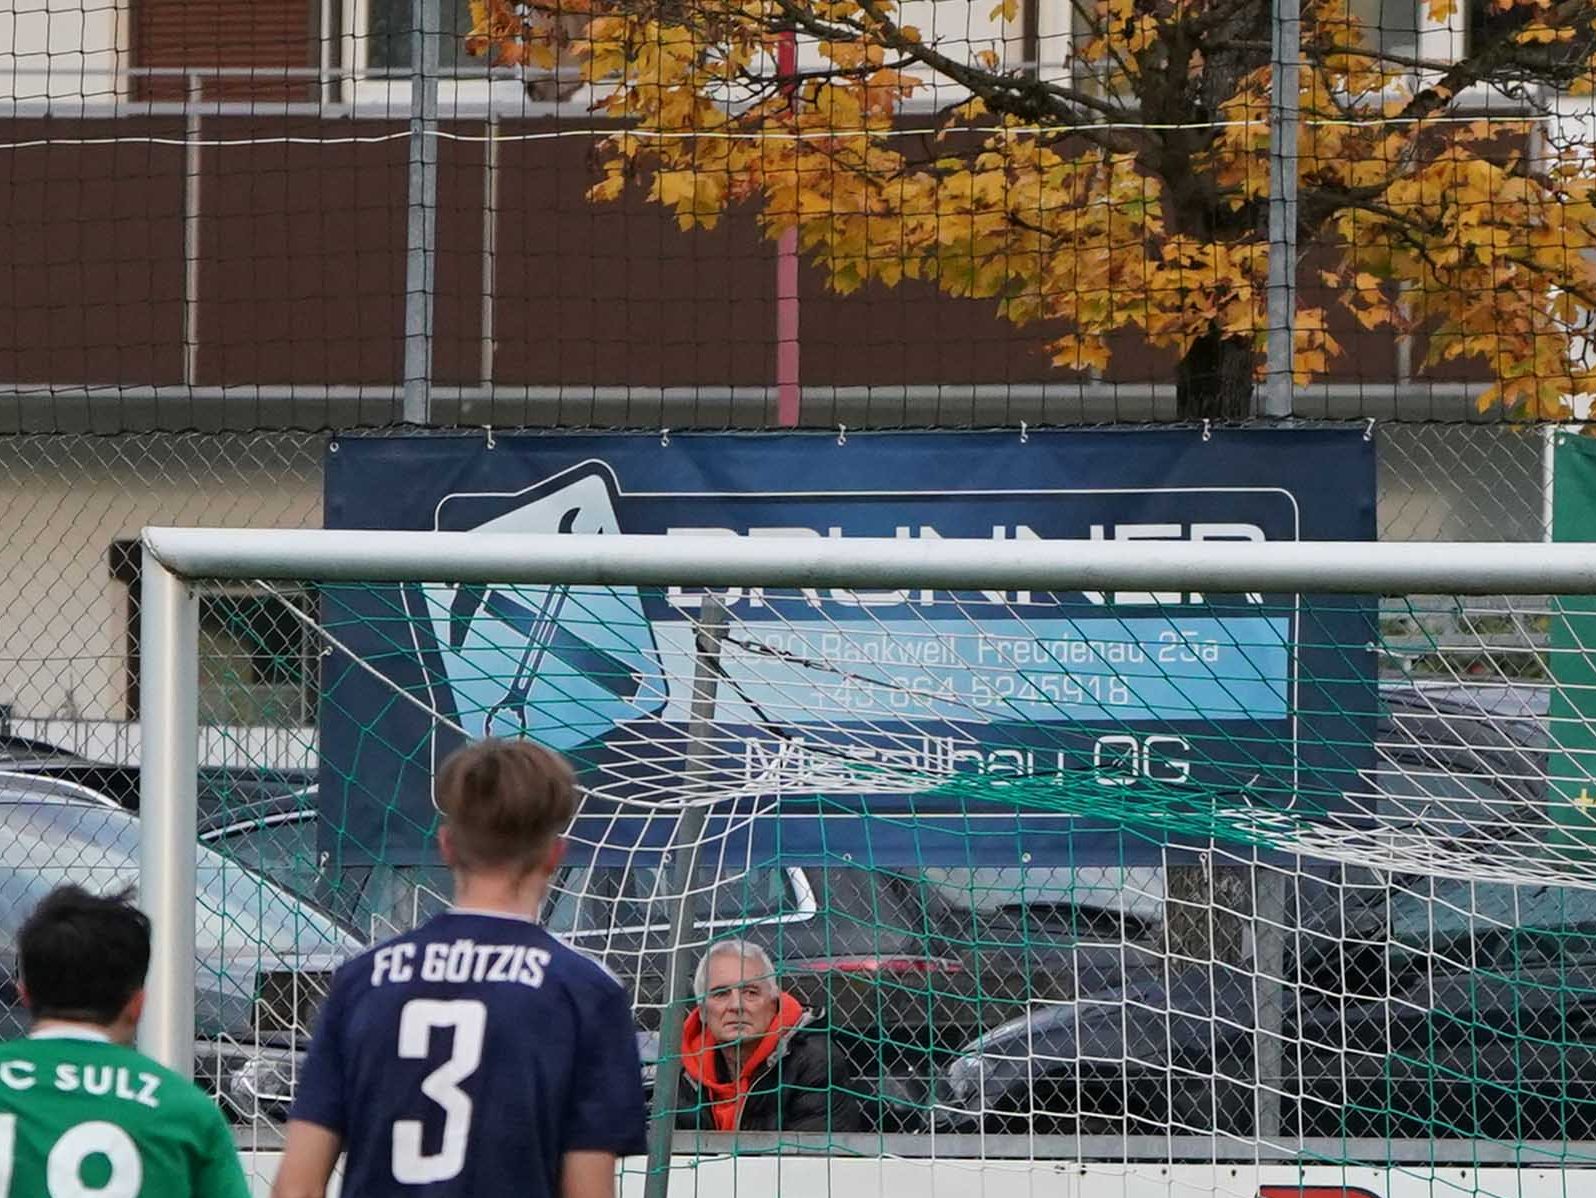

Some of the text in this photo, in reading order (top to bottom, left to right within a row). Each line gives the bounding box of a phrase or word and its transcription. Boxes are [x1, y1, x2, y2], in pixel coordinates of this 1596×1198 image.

[1093, 734, 1191, 786] OG
[371, 940, 551, 990] FC GÖTZIS
[53, 1062, 162, 1109] SULZ
[391, 999, 488, 1185] 3
